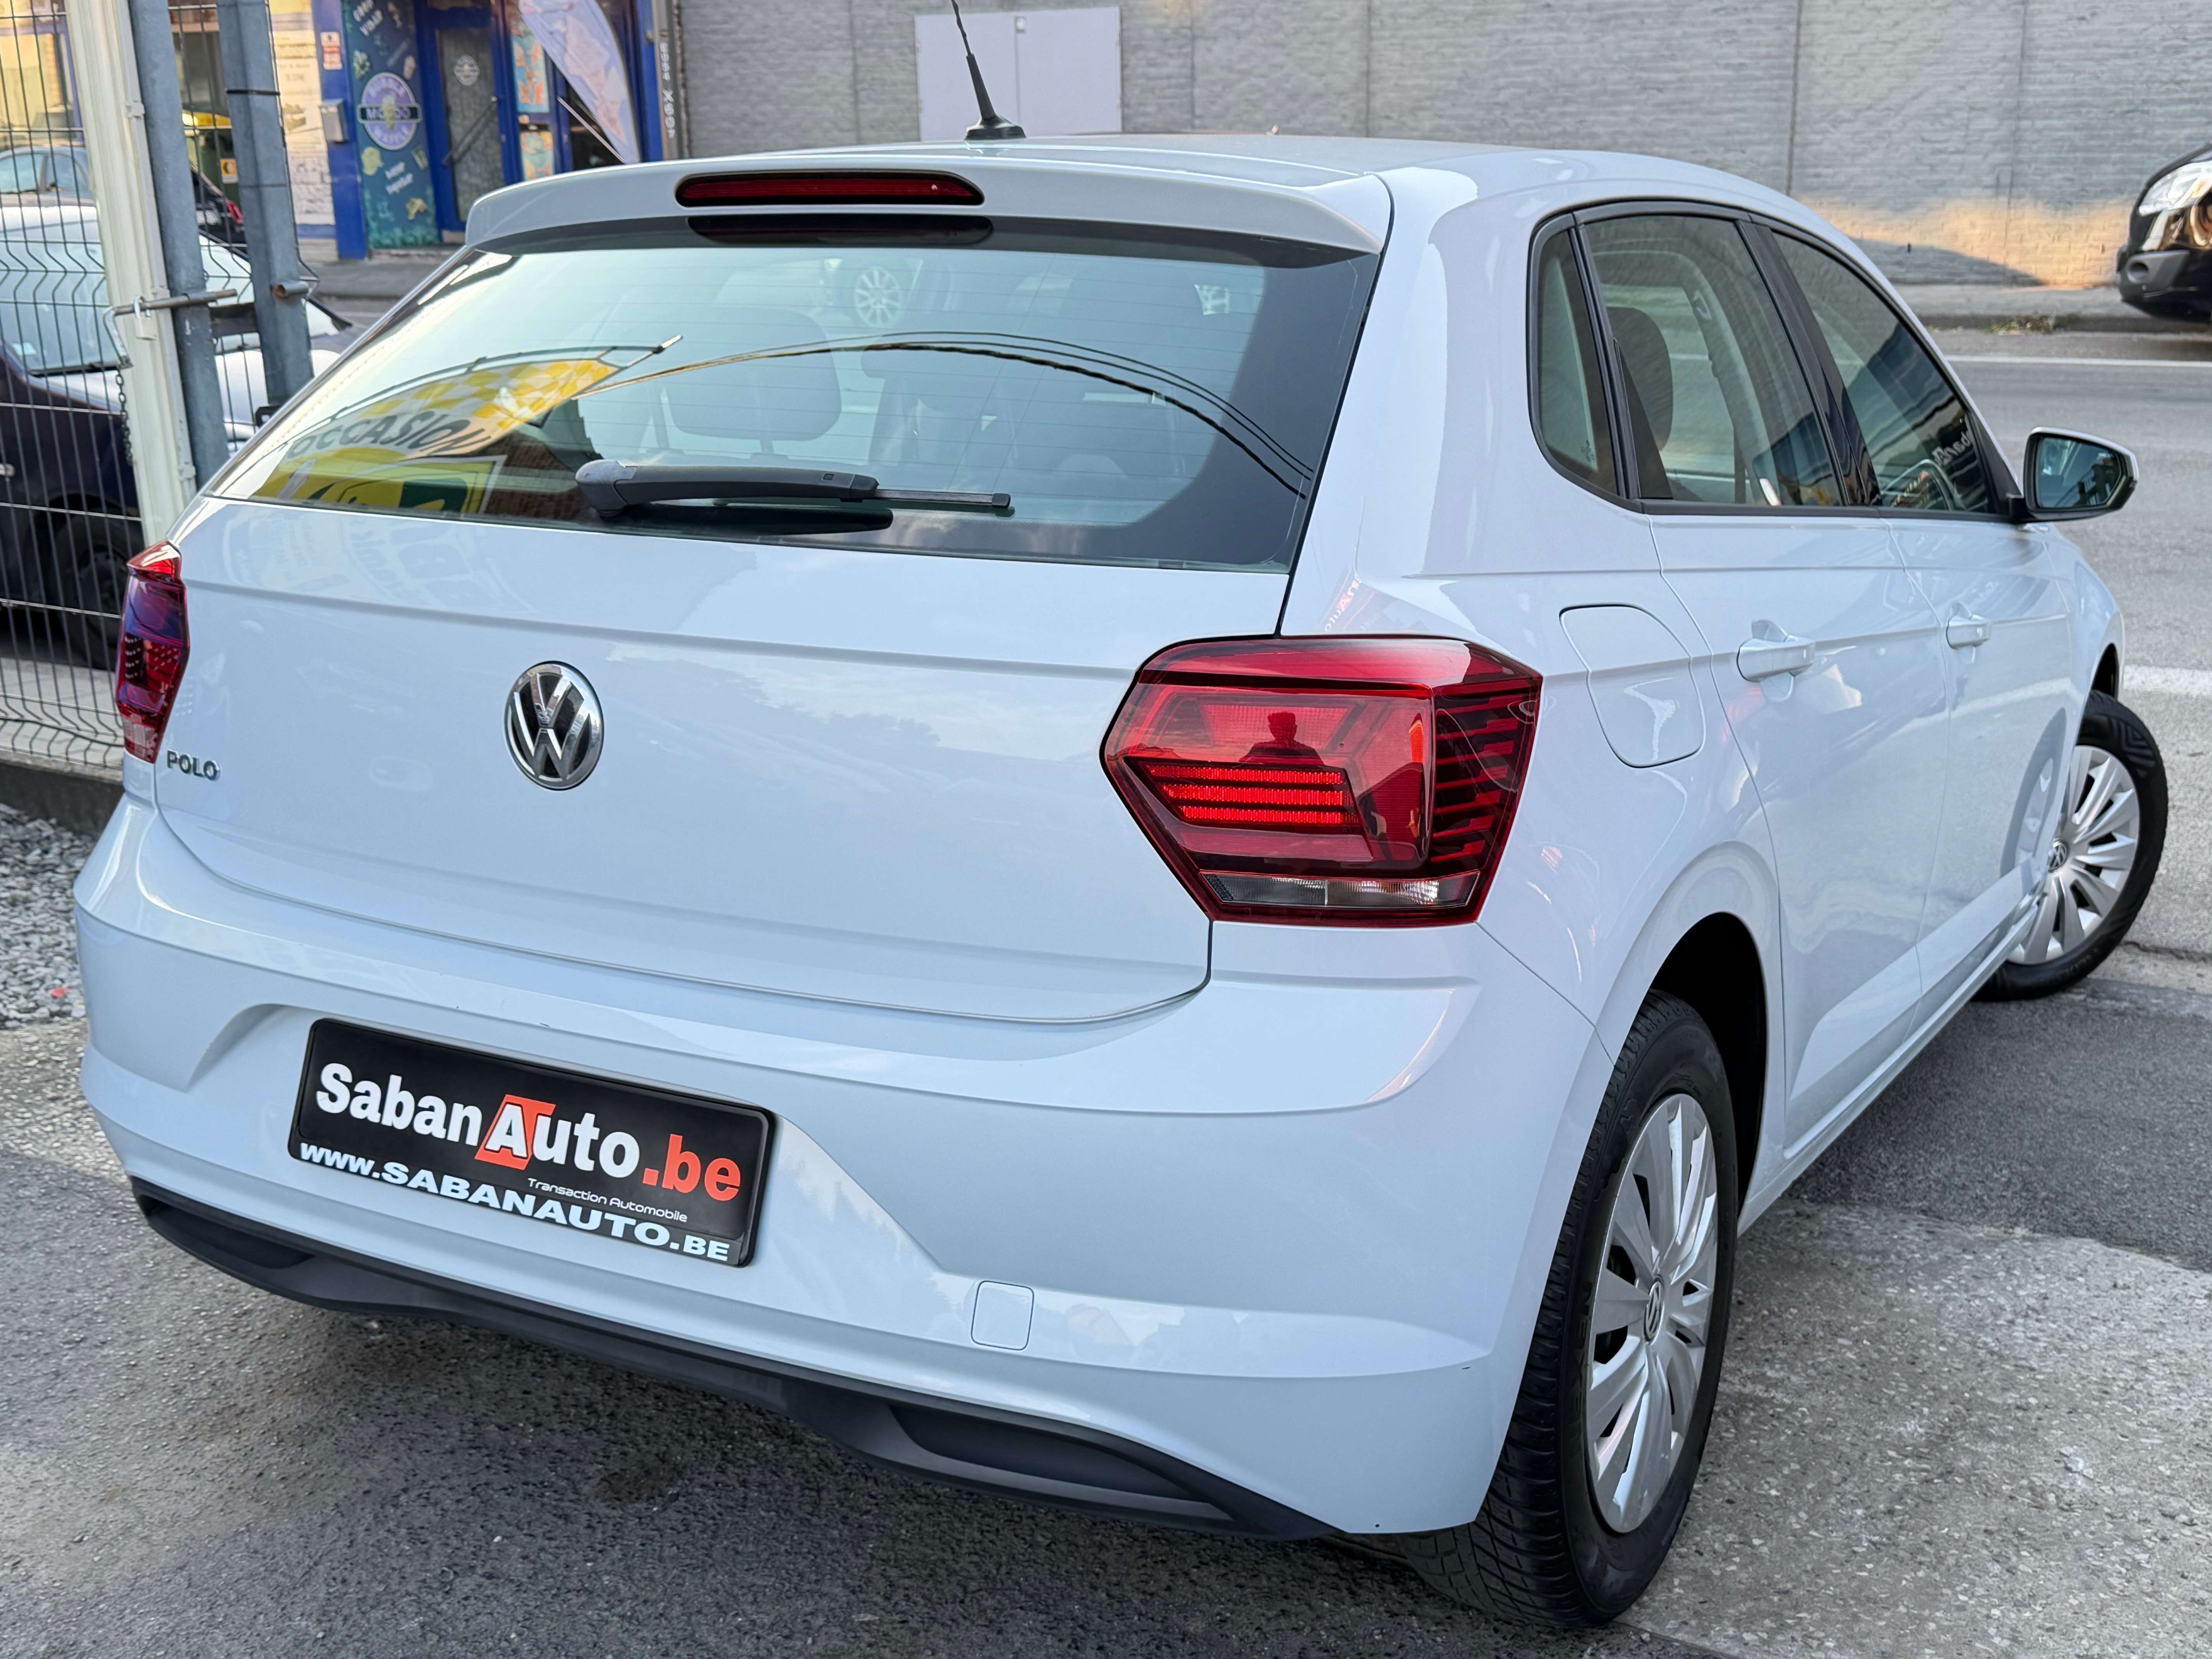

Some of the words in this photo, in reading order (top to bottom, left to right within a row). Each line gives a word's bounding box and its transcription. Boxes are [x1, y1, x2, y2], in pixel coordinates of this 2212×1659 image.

[287, 410, 491, 459] OCCASION
[167, 749, 221, 781] POLO
[300, 1142, 730, 1261] www.SABANAUTO.BE
[527, 1178, 607, 1205] Transaction
[609, 1197, 689, 1223] Automobile
